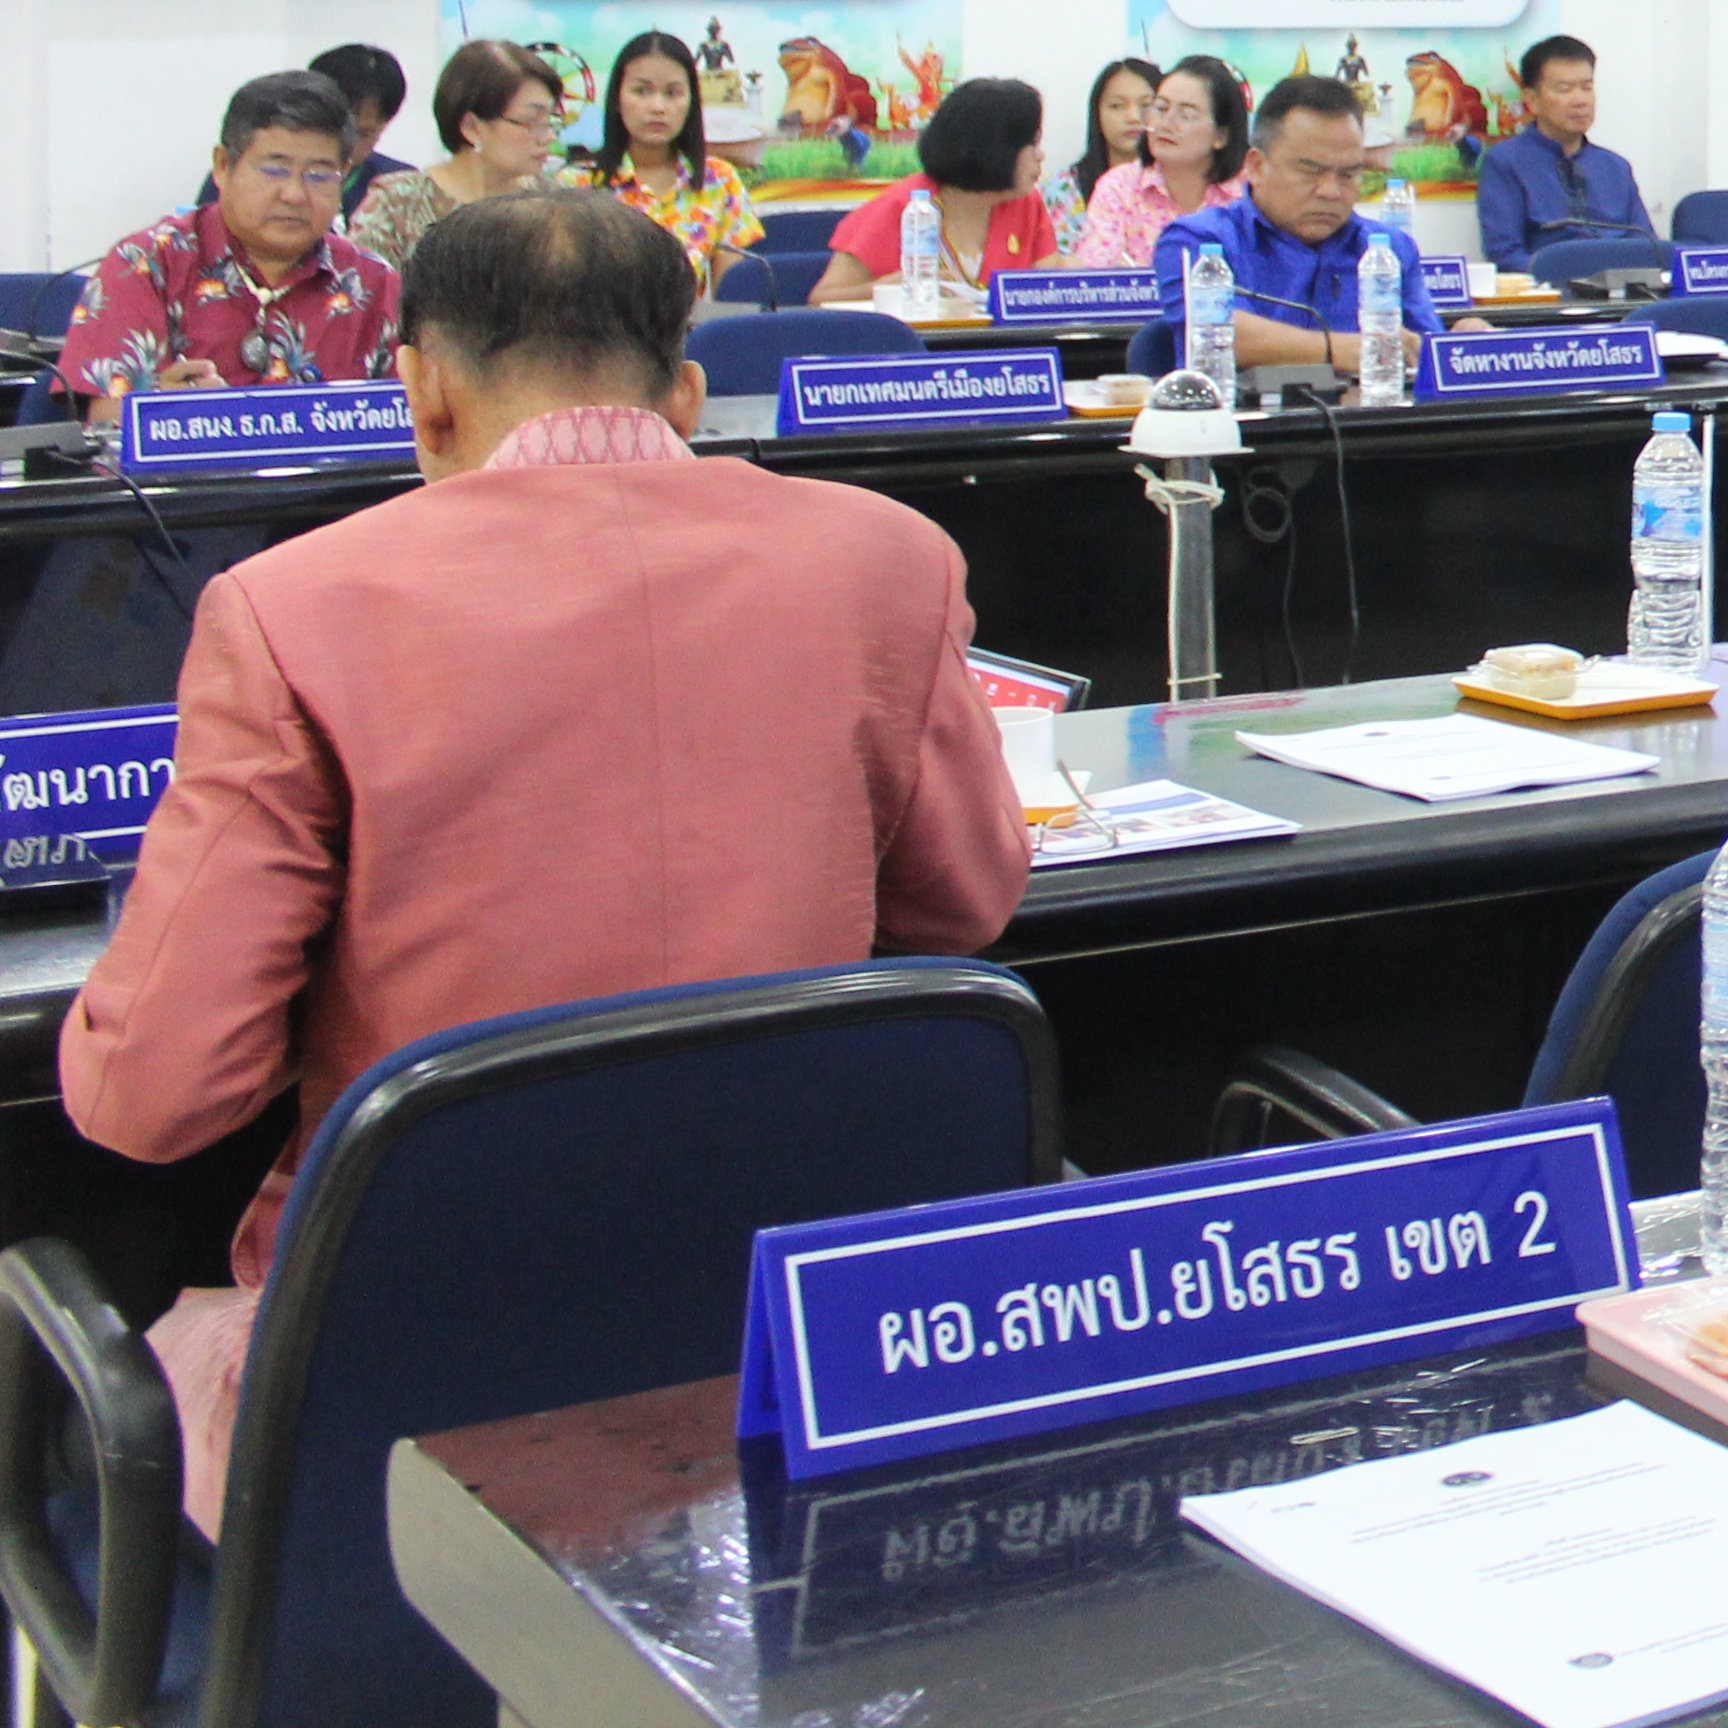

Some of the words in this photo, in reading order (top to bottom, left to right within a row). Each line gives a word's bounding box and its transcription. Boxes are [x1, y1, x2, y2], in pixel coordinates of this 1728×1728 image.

[1004, 277, 1160, 307] นายกองค์การบริหารส่วนจังหวั
[1449, 337, 1643, 375] จัดหางานจังหวัดยโสธร
[803, 364, 1051, 407] นายกเทศมนตรีเมืองยโสธร
[310, 397, 415, 433] จังหวัดยโส
[877, 1219, 1361, 1375] ผอ.สพป.ยโสธร
[1385, 1207, 1491, 1283] เขต
[1513, 1189, 1558, 1259] 2
